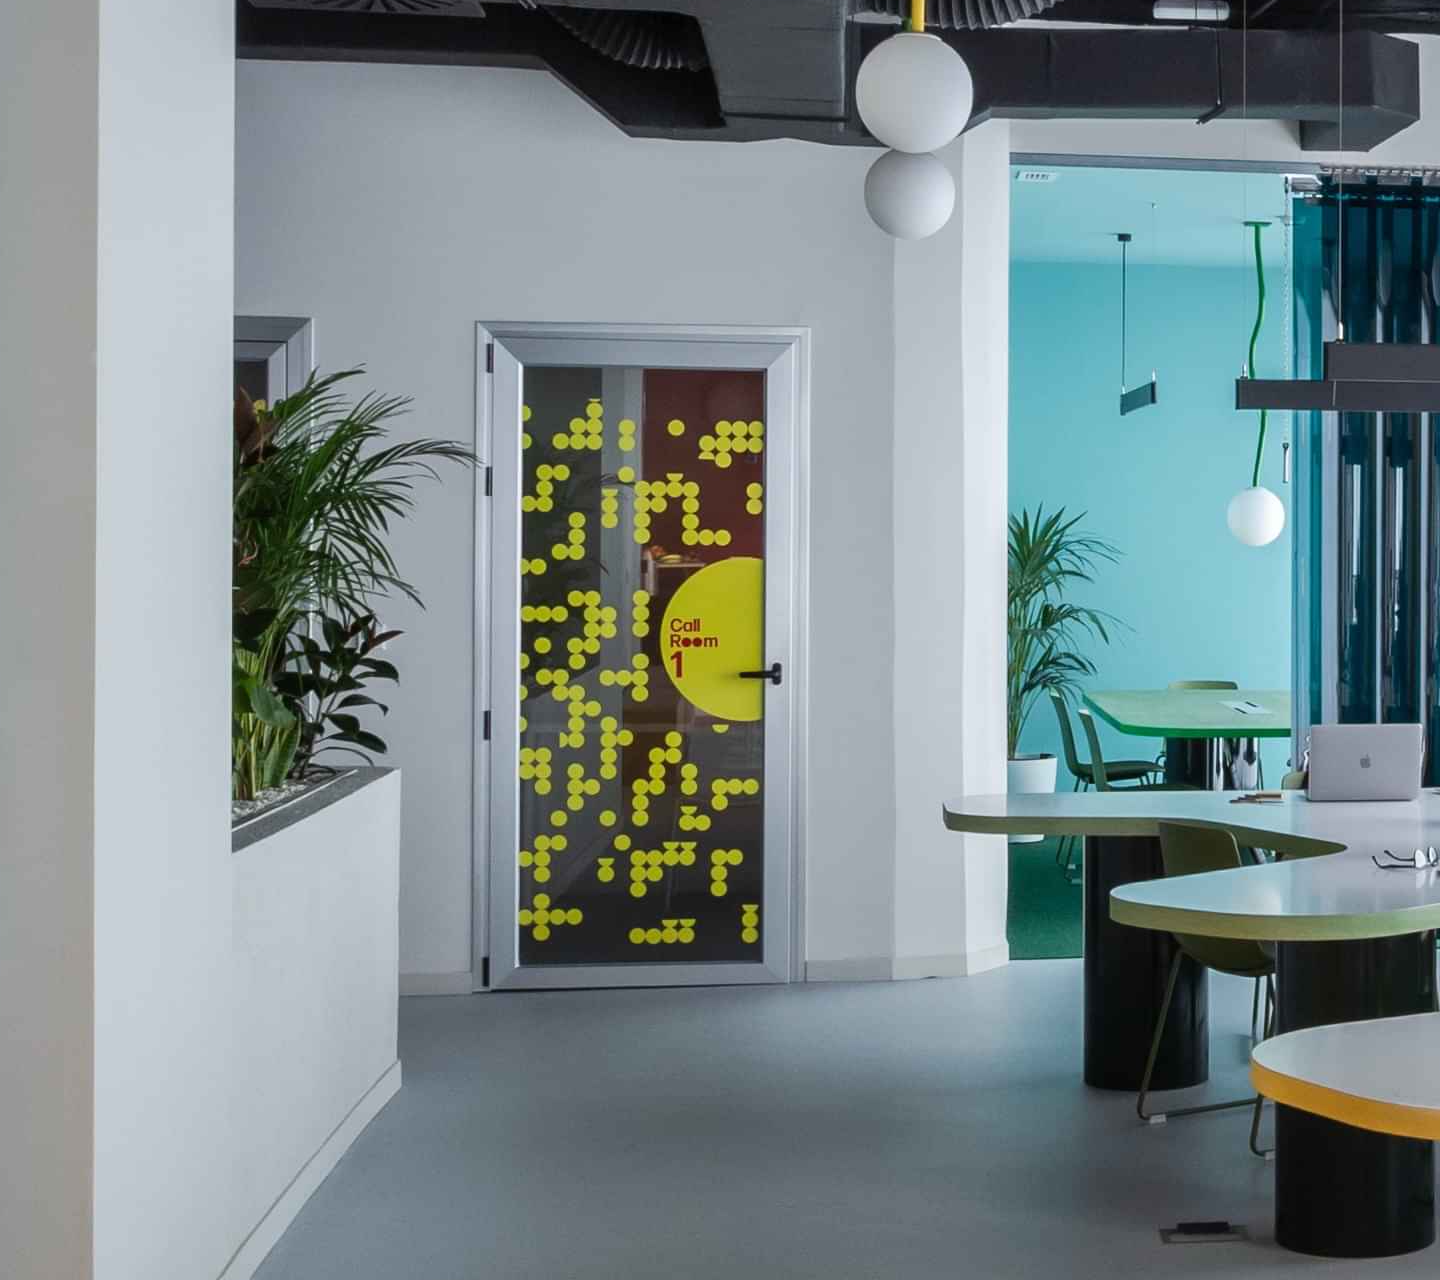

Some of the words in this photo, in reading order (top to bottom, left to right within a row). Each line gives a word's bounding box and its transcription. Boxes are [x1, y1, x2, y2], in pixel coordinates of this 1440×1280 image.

[670, 618, 701, 633] Call
[670, 634, 719, 648] Room
[670, 650, 683, 678] 1
